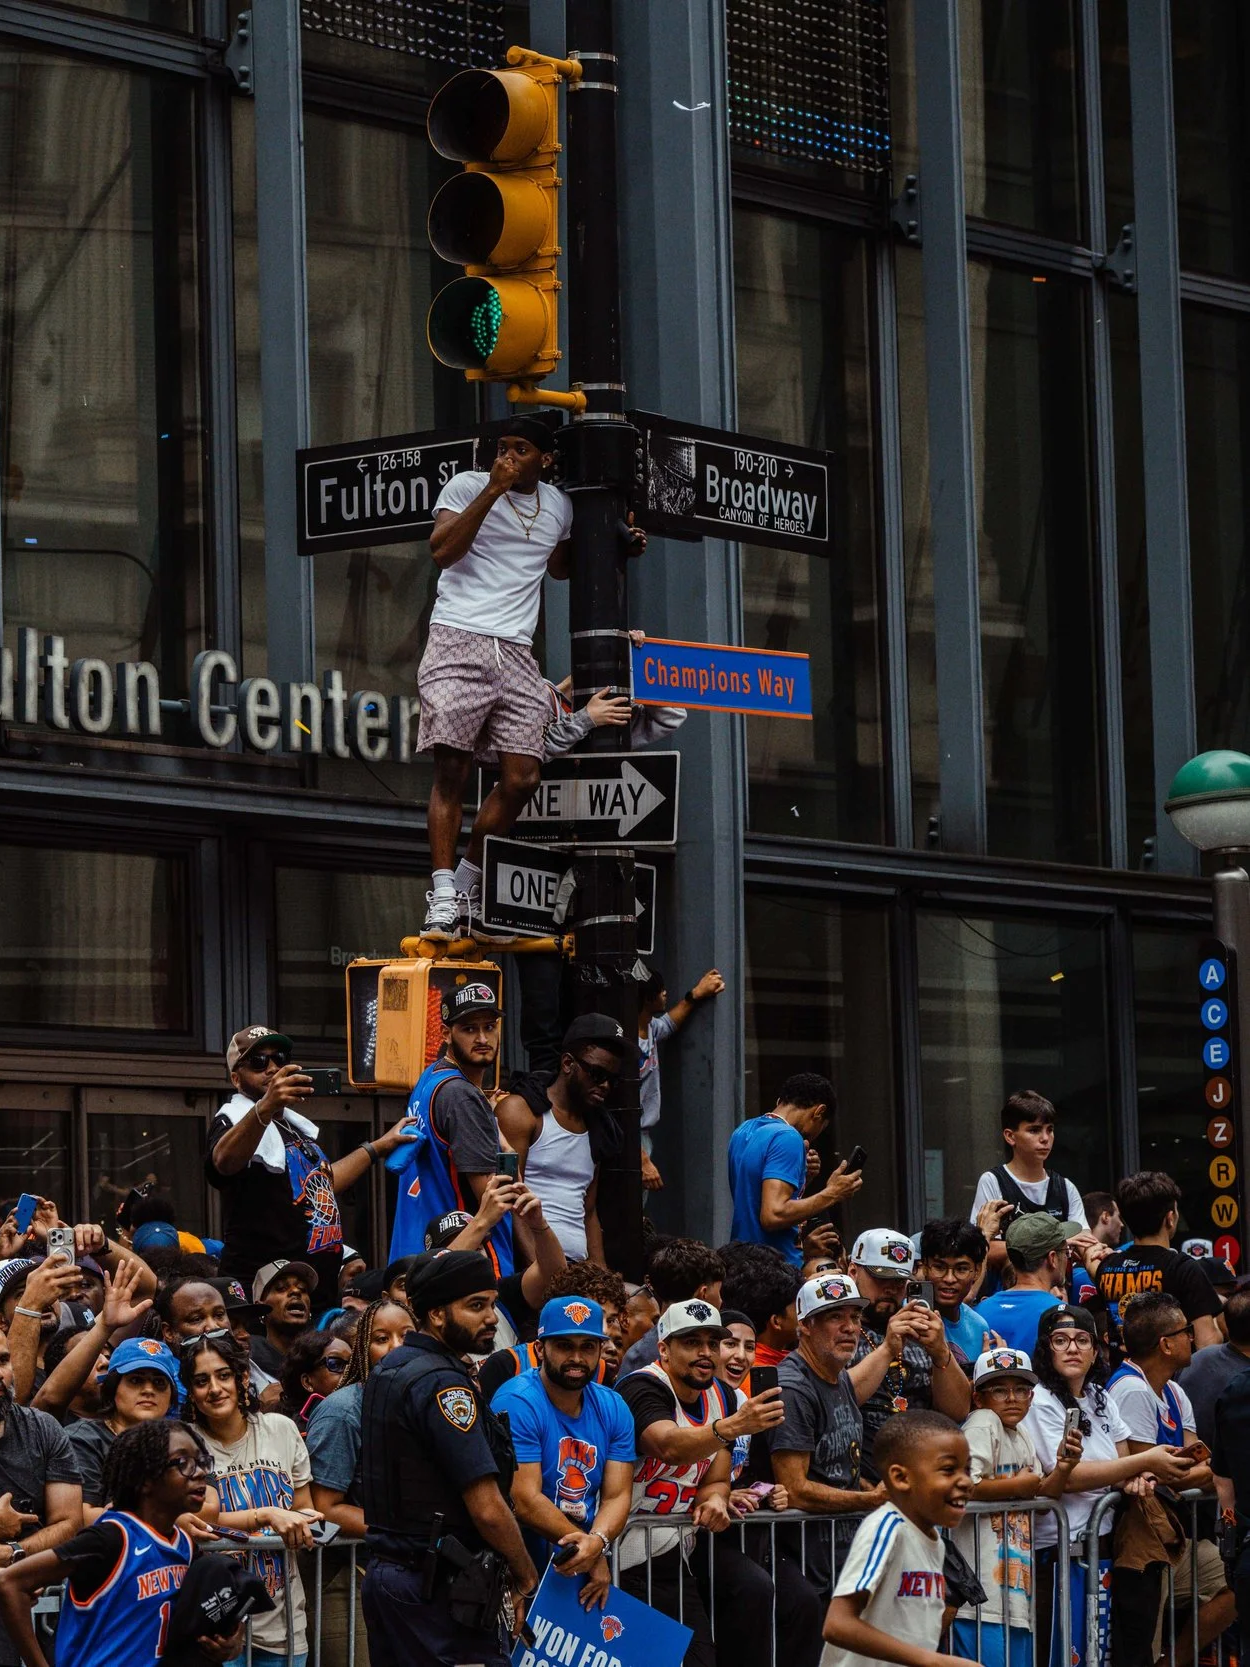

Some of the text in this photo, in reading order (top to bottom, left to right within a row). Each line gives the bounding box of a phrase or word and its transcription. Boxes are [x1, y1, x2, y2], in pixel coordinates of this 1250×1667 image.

[377, 449, 421, 472] 126-158
[733, 450, 778, 478] 190-210
[319, 472, 429, 524] Fulton
[706, 463, 818, 532] Broadway
[719, 506, 805, 535] CANYON OF HEROES
[643, 656, 795, 705] Champions Way
[190, 649, 419, 764] Center
[527, 782, 646, 817] NE WAY
[510, 870, 557, 908] ONE
[1205, 964, 1220, 984] A
[455, 990, 476, 1007] FINALS
[1207, 1004, 1221, 1025] C
[1209, 1043, 1223, 1063] E
[1213, 1082, 1224, 1103] J
[1214, 1122, 1227, 1142] Z
[1216, 1162, 1230, 1182] R
[1215, 1203, 1234, 1223] W
[1221, 1241, 1231, 1260] 1
[216, 1467, 295, 1513] HAMPS
[137, 1567, 170, 1601] NEW
[530, 1614, 581, 1667] WON
